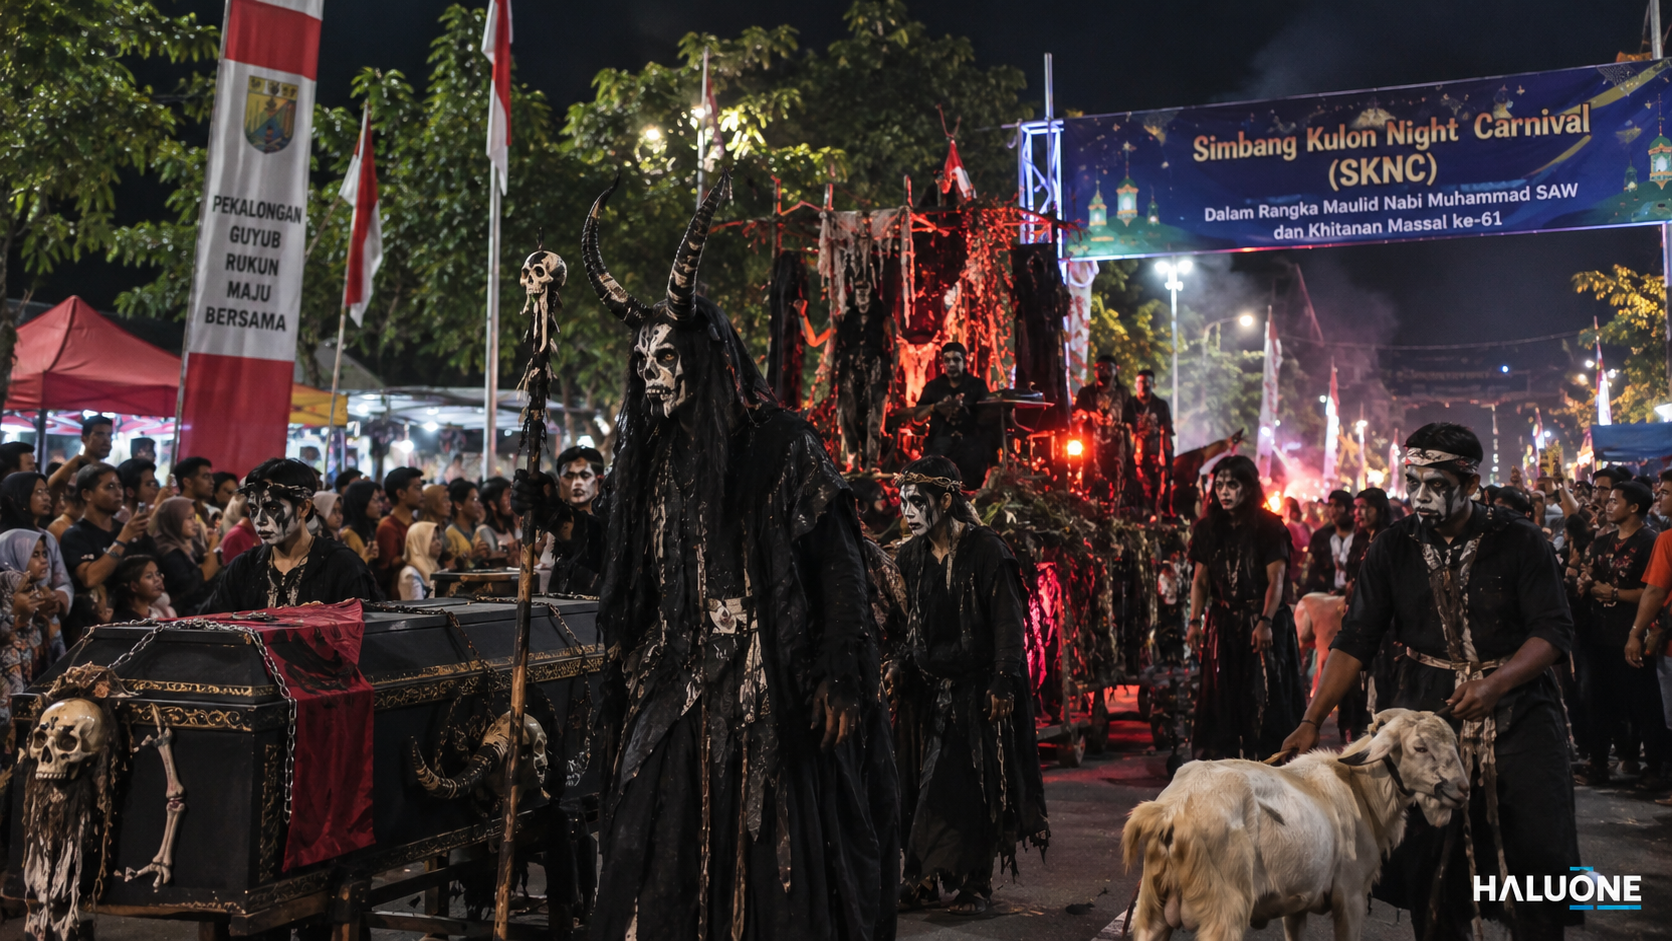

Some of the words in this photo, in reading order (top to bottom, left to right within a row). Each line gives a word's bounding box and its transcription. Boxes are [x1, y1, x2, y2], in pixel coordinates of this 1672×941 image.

[1193, 133, 1297, 163] Simbang
[1306, 126, 1376, 153] Kulon
[1387, 117, 1459, 148] Night
[1473, 102, 1592, 139] Carnival
[1328, 152, 1438, 190] (SKNC)
[212, 195, 302, 224] PEKALONGAN
[1204, 205, 1255, 222] Dalam
[1259, 202, 1319, 221] Rangka
[1323, 197, 1380, 215] Maulid
[1384, 194, 1424, 211] Nabi
[1428, 187, 1531, 208] Muhammad
[1536, 182, 1579, 199] SAW
[229, 225, 282, 249] GUYUB
[1273, 224, 1304, 240] dan
[1308, 220, 1383, 238] Khitanan
[1388, 215, 1449, 233] Massal
[1453, 211, 1502, 231] ke-61
[225, 253, 280, 277] RUKUN
[226, 280, 272, 303] MAJU
[204, 306, 287, 332] BERSAMA
